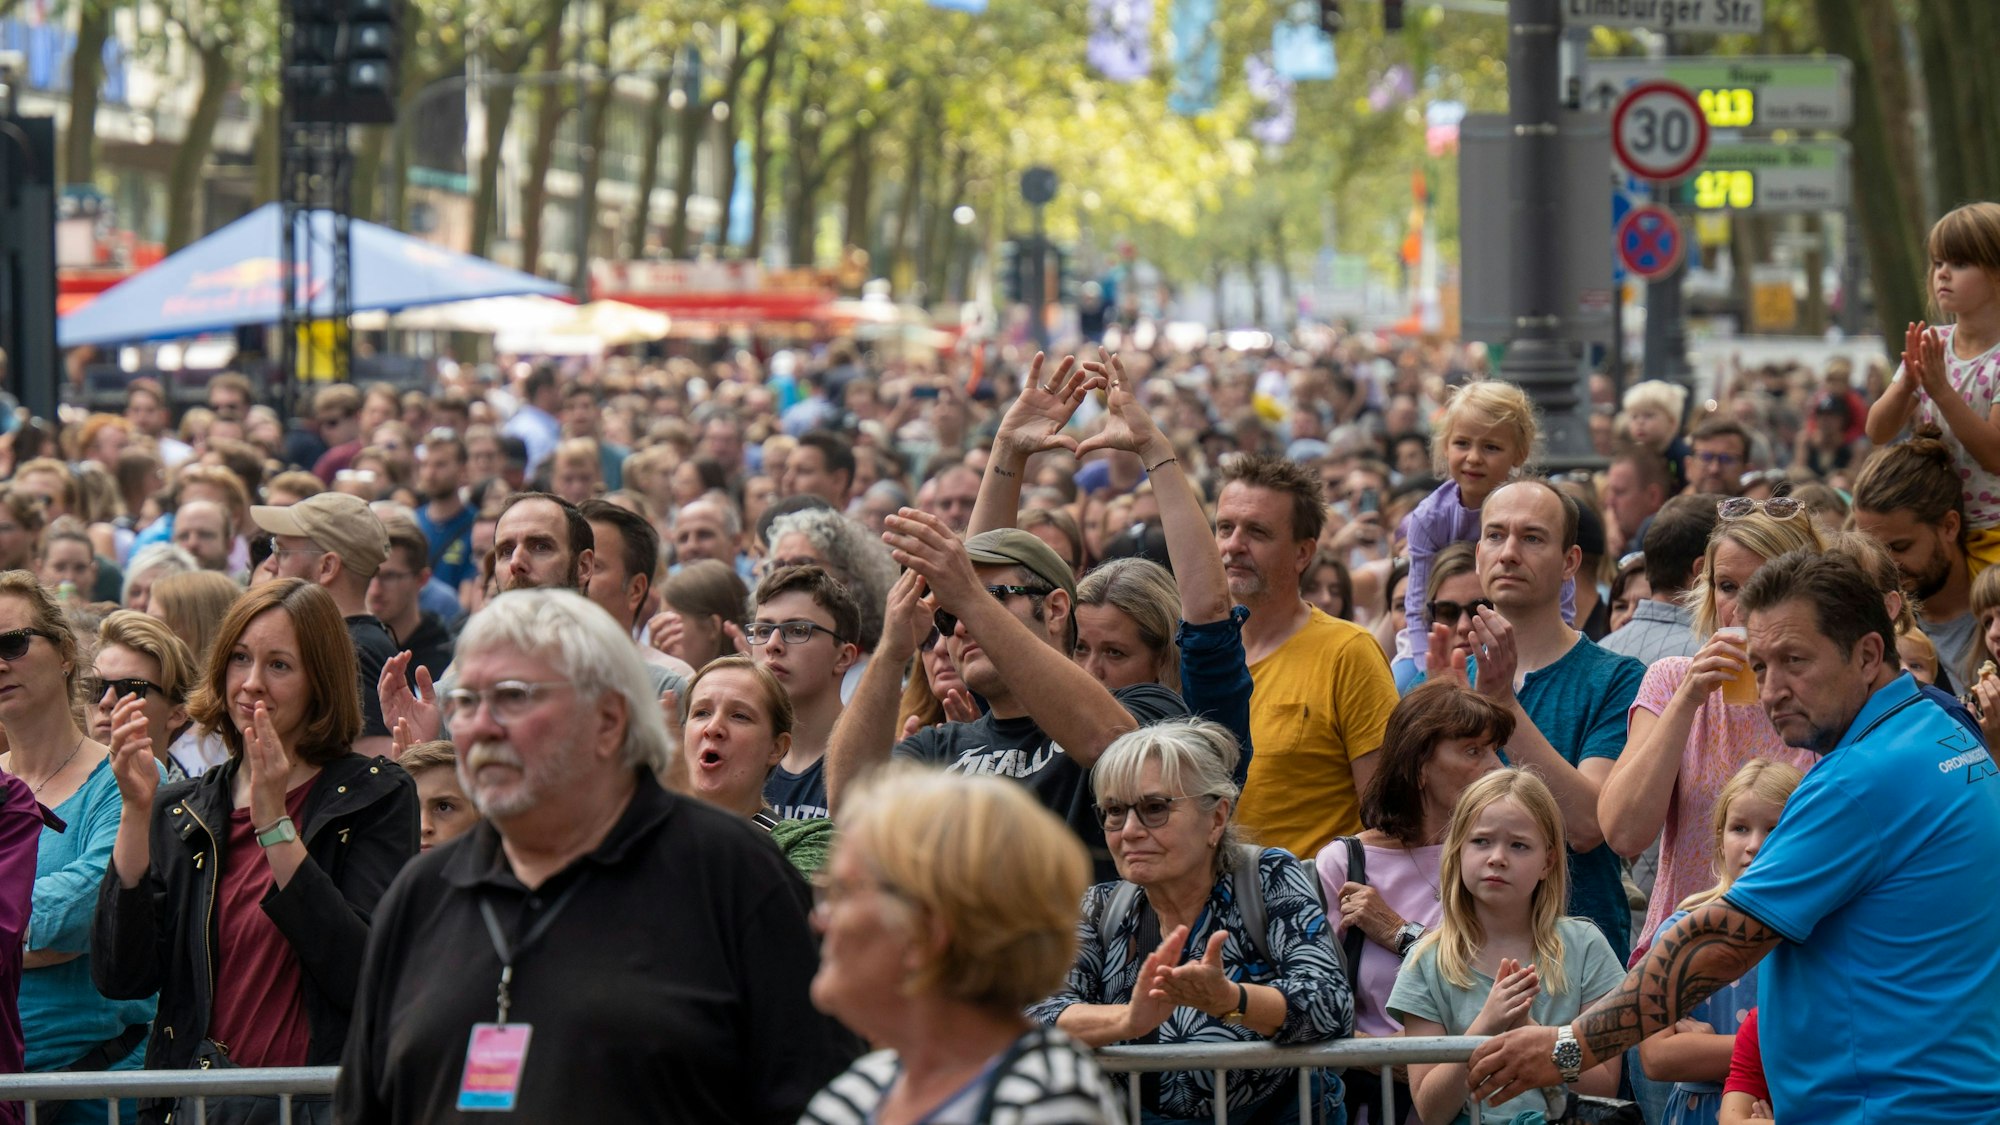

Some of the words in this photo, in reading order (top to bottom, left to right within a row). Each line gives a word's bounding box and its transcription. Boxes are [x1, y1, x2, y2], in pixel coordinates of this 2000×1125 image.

[1568, 0, 1703, 27] Limburger
[1713, 0, 1758, 25] Str.
[1631, 106, 1689, 156] 30
